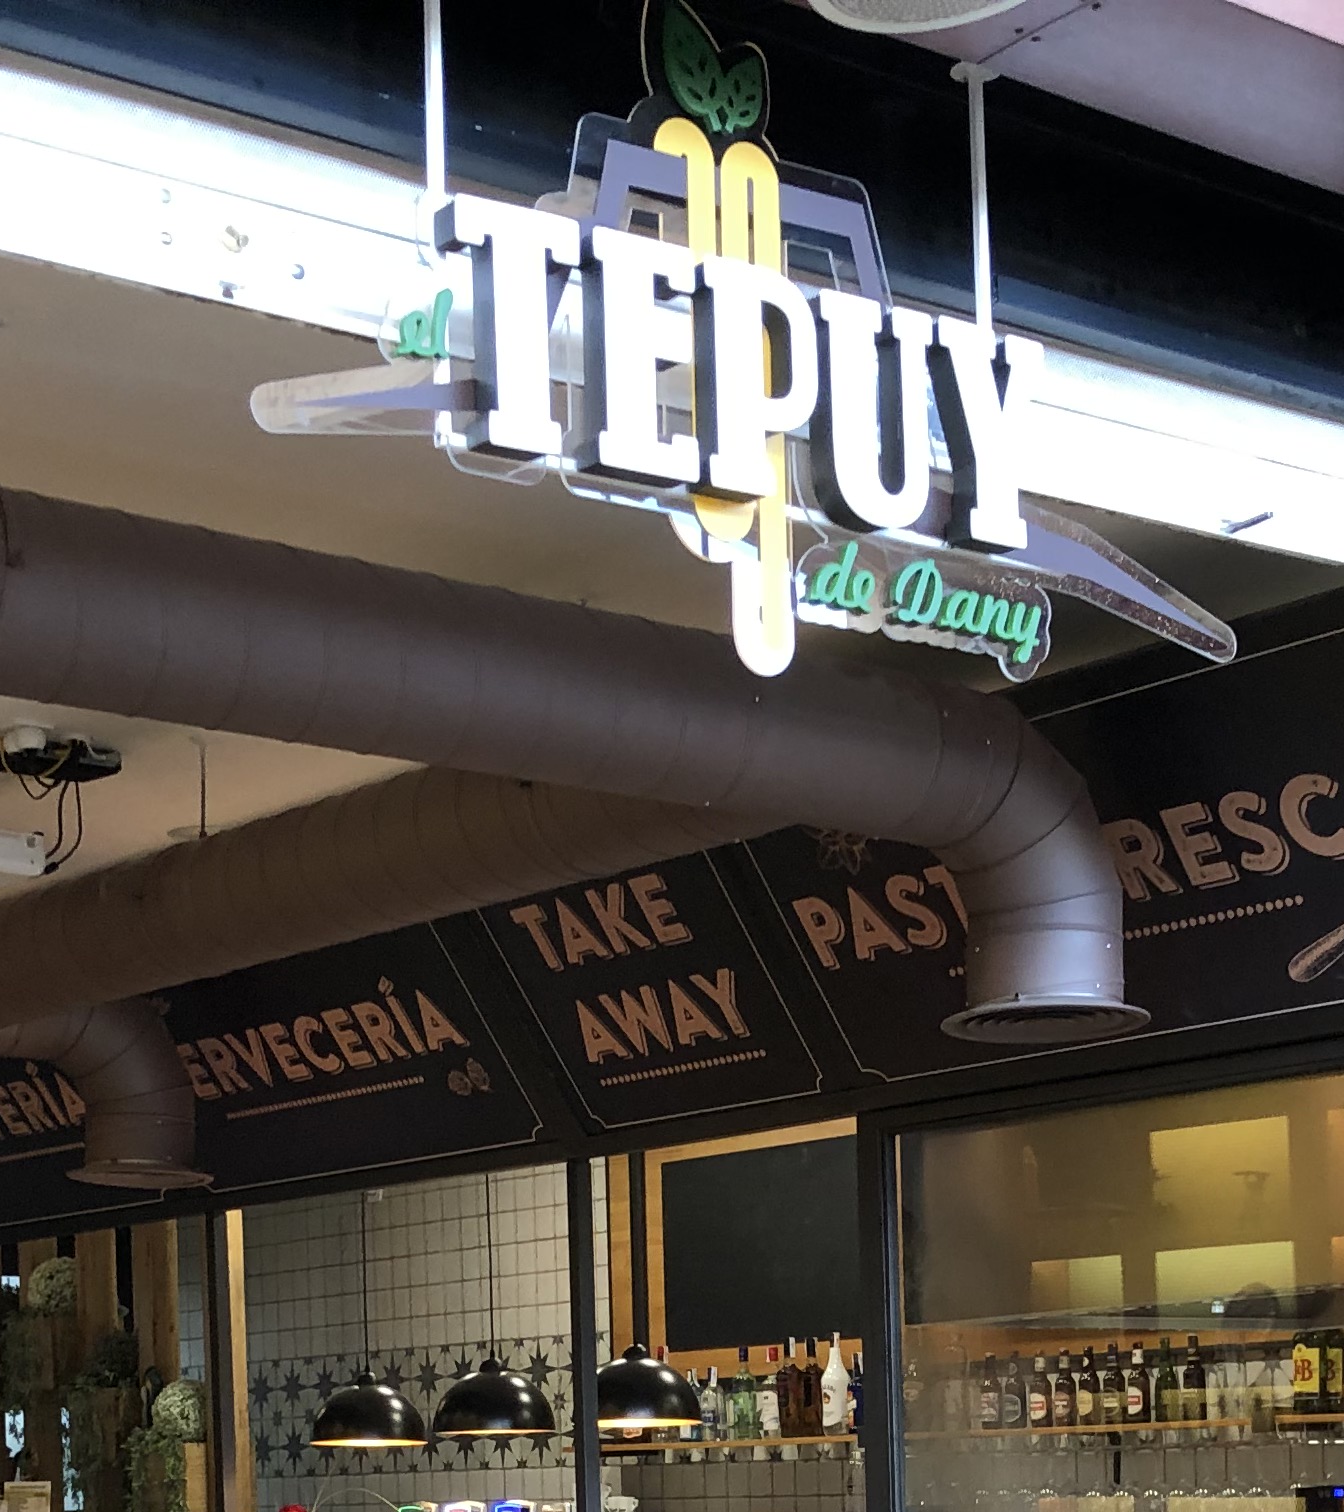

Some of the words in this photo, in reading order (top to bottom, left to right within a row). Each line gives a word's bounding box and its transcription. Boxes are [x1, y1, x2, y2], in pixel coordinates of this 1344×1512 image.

[395, 288, 453, 358] el
[434, 193, 1045, 552] TEPUY
[810, 541, 872, 613] de
[890, 558, 1042, 664] Dany
[509, 873, 694, 971] TAKE
[791, 864, 969, 971] PAST
[176, 975, 471, 1099] ERVECERÍA
[575, 968, 752, 1064] AWAY
